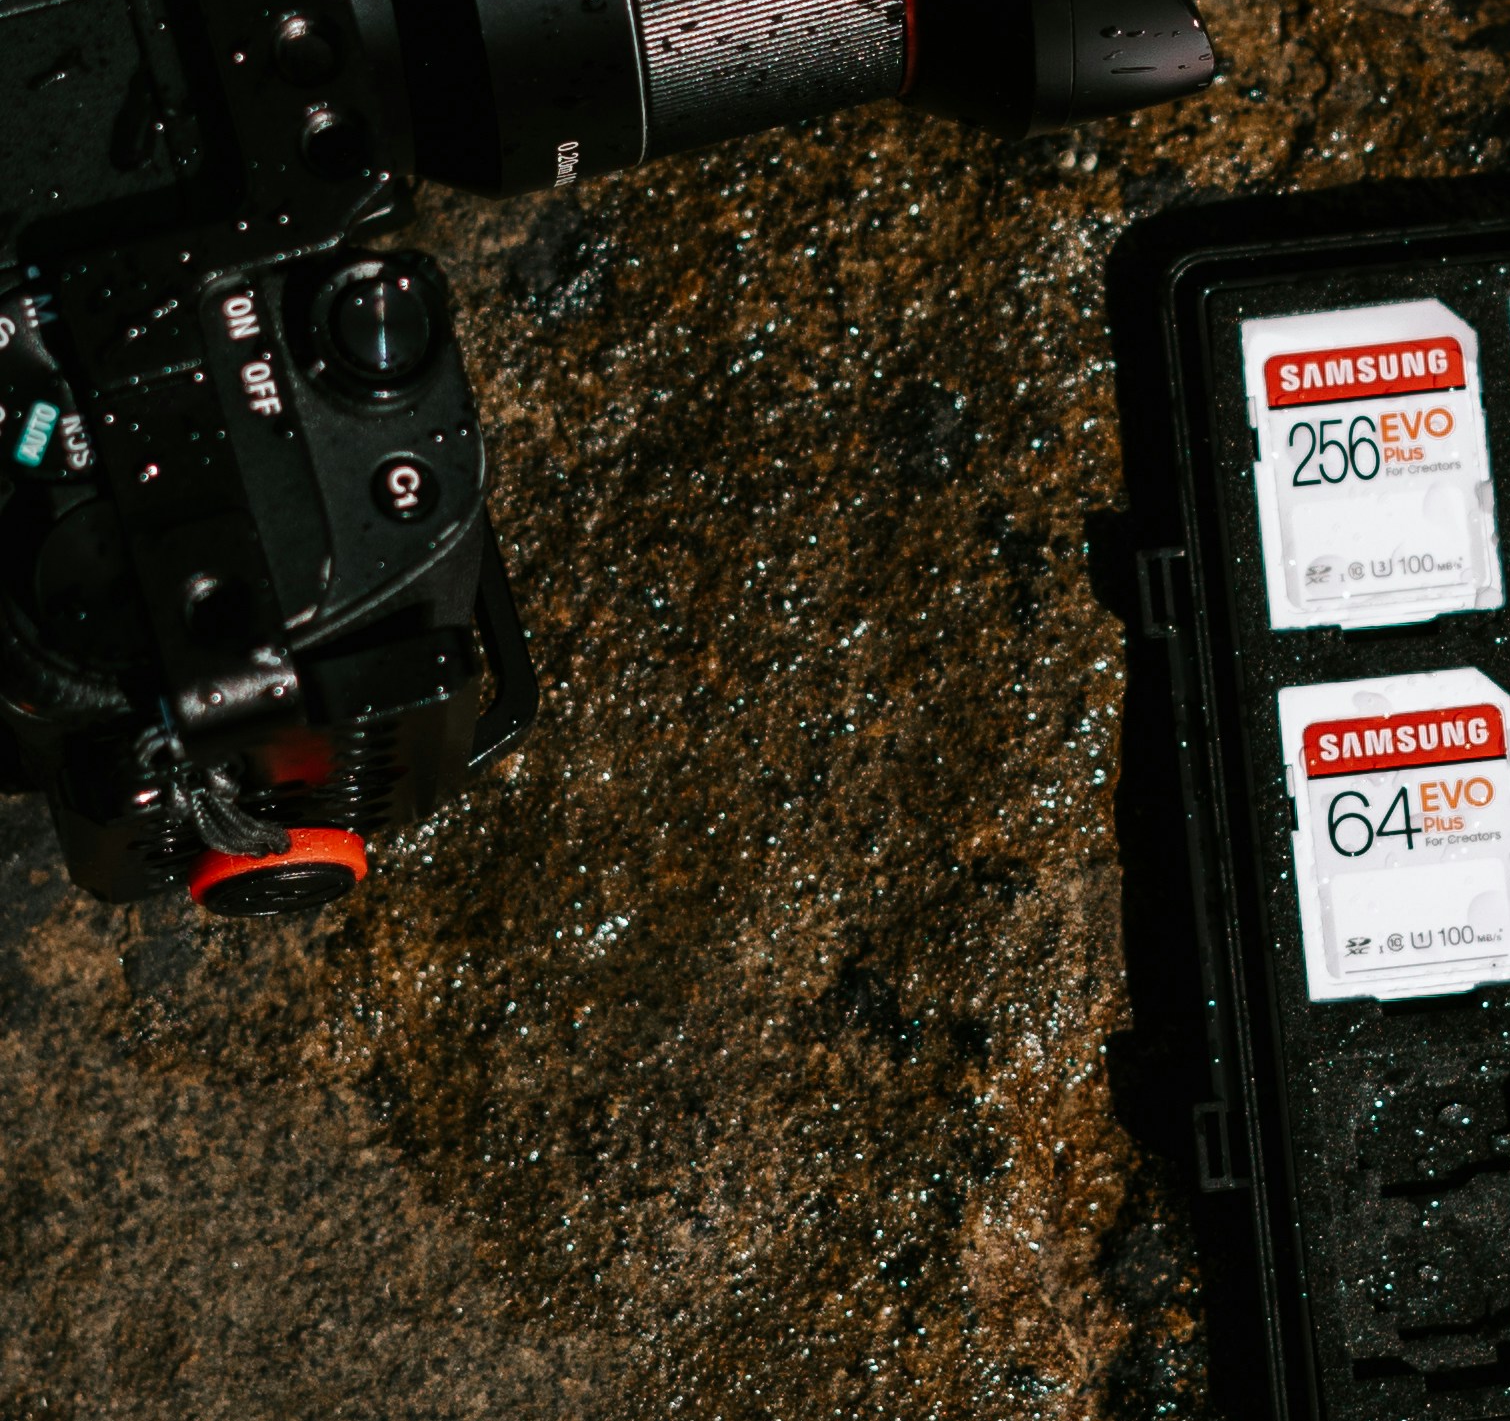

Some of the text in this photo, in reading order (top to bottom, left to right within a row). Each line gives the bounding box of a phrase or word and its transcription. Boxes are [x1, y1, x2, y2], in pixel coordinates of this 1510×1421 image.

[223, 296, 260, 340] ON
[241, 362, 282, 416] OFF
[1280, 348, 1448, 392] SAMSUNG
[20, 403, 57, 461] AUTO
[1288, 407, 1454, 487] 256 EVO
[1384, 445, 1424, 463] Plus
[388, 466, 421, 510] C1
[1386, 465, 1405, 477] For
[1400, 554, 1434, 574] 100
[1319, 717, 1489, 762] SAMSUNG
[1328, 777, 1493, 857] 64 EVO
[1424, 815, 1464, 833] Plus
[1425, 836, 1443, 847] For
[1438, 925, 1474, 946] 100
